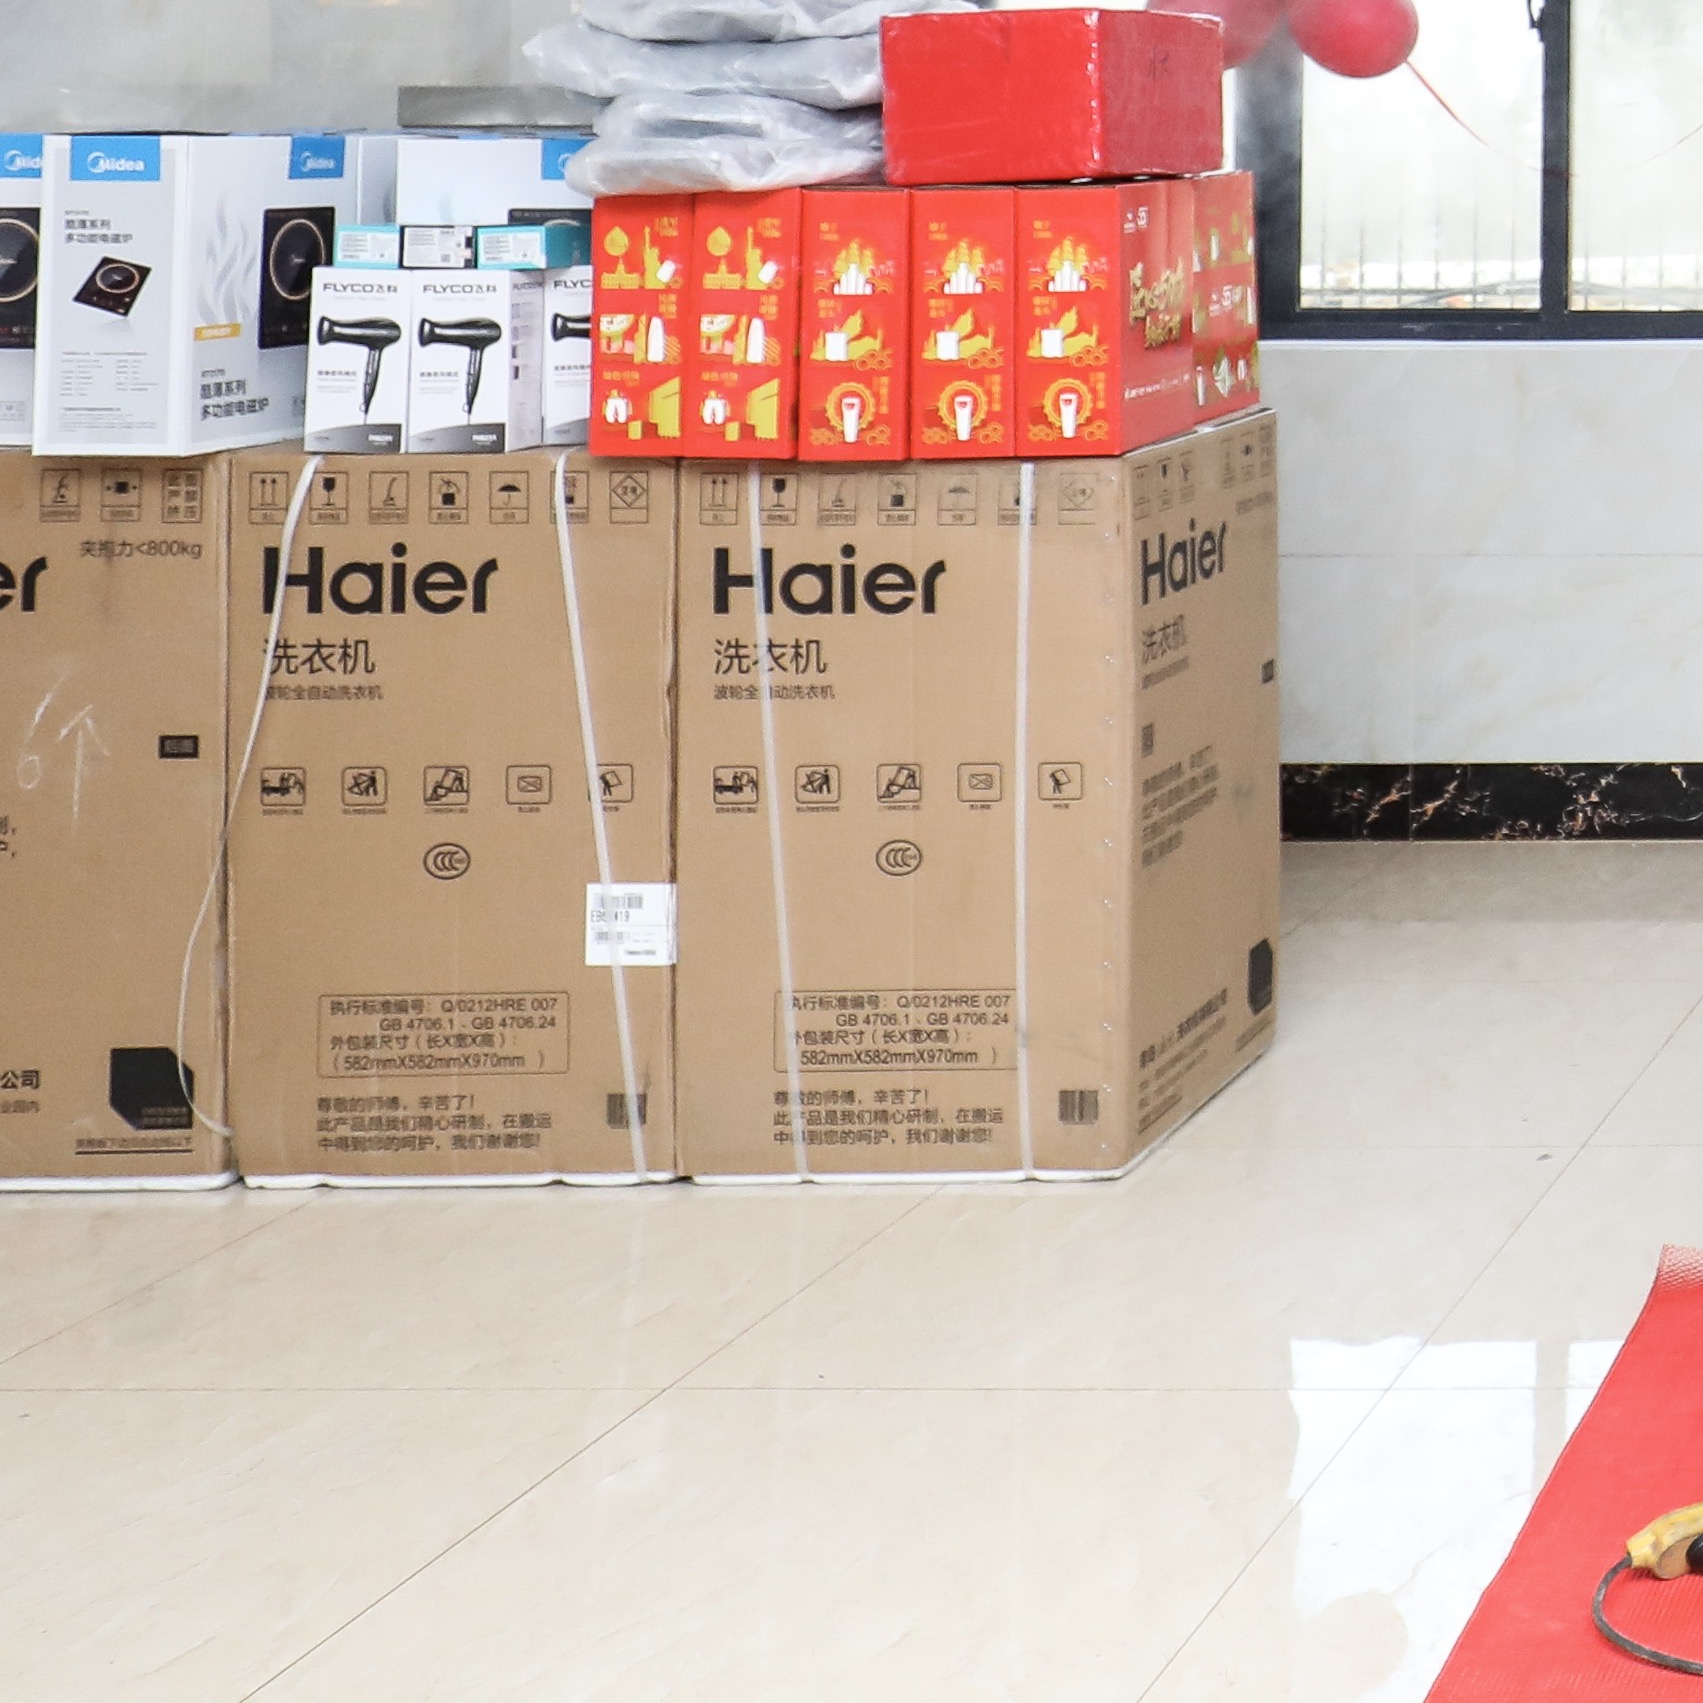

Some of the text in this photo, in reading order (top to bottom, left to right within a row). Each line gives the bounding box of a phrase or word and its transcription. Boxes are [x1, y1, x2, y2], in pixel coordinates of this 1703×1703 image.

[87, 151, 145, 174] Midea
[1140, 517, 1227, 606] Haier
[262, 541, 499, 614] Haier
[713, 543, 947, 614] Haier
[262, 637, 376, 676] 洗衣机
[713, 637, 828, 676] 洗衣机
[531, 998, 558, 1011] 007
[984, 995, 1010, 1008] 007
[379, 1018, 402, 1031] GB
[471, 1017, 494, 1030] GB
[499, 1016, 557, 1030] 4706.24
[836, 1014, 857, 1027] GB
[926, 1012, 948, 1026] GB
[952, 1012, 1009, 1026] 4706.24
[773, 1108, 1004, 1127] 此品是我们精心研制，在搬运
[773, 1128, 992, 1146] 中到您的呵护，我们谢谢您！
